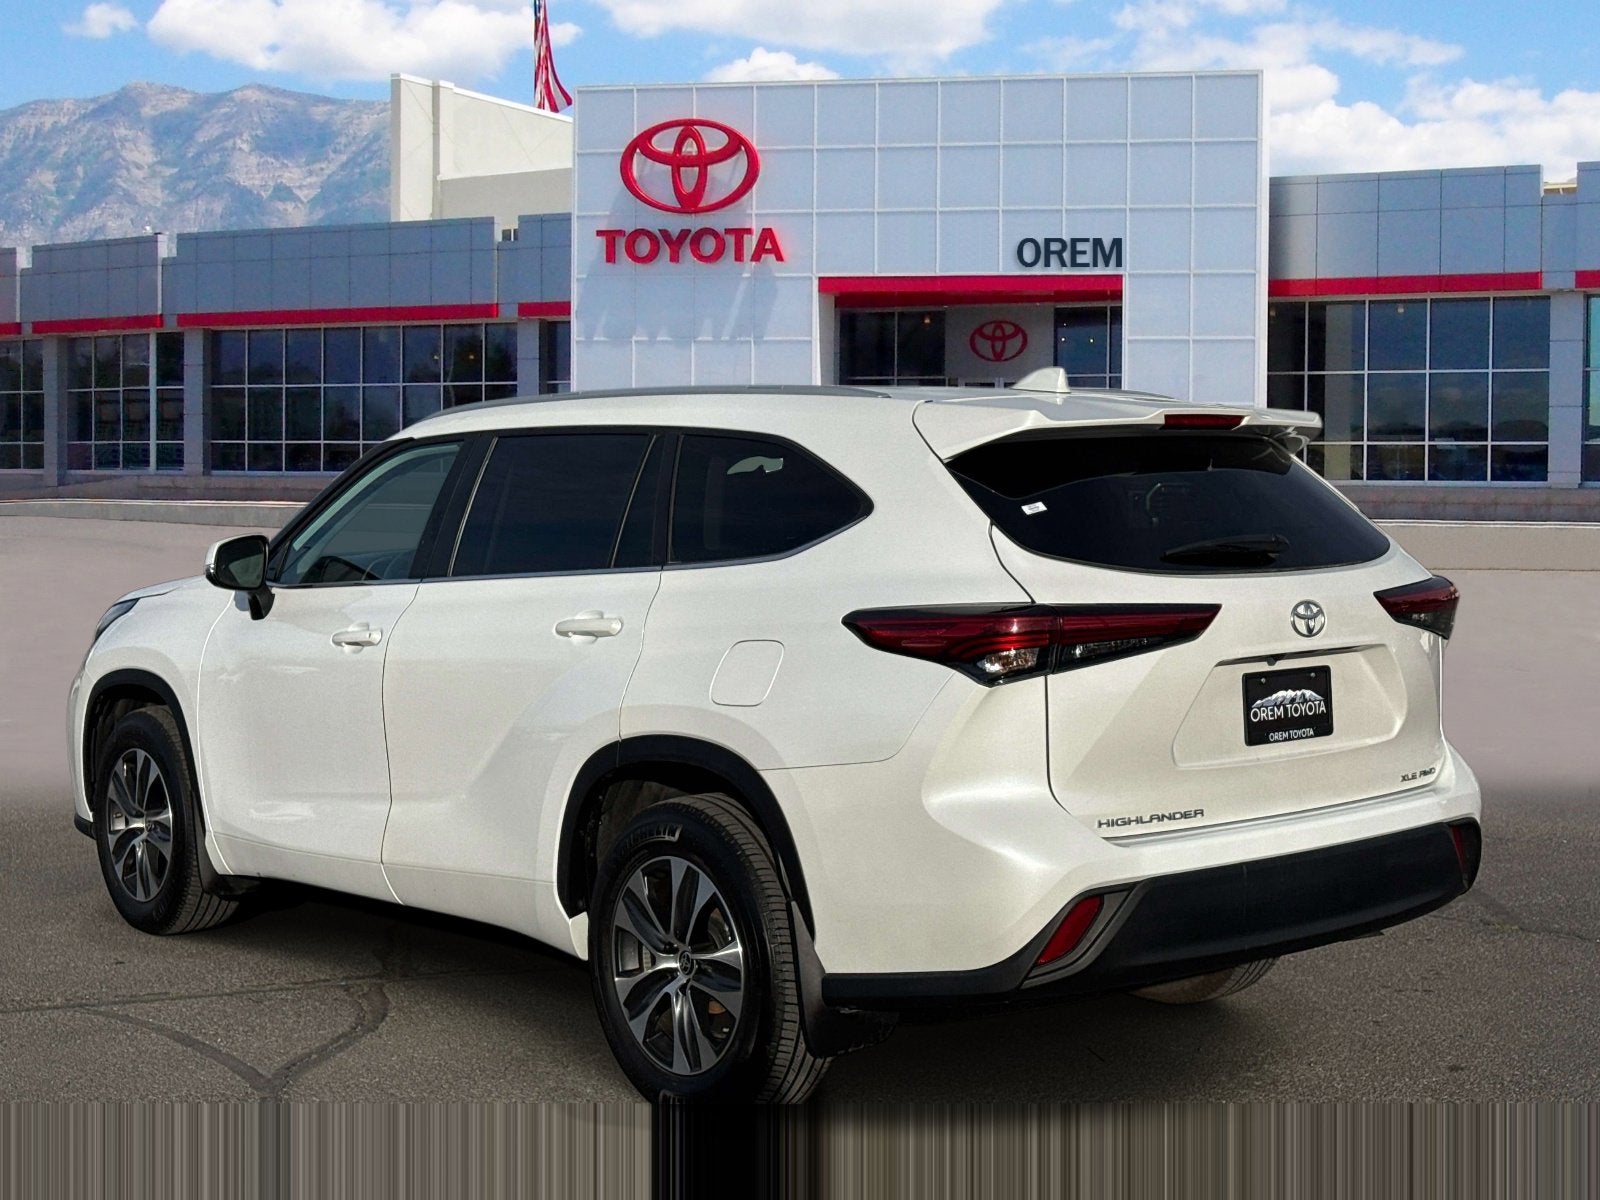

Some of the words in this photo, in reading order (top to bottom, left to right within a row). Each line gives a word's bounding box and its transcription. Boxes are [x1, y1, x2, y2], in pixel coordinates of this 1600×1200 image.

[596, 227, 784, 264] TOYOTA
[1017, 238, 1123, 267] OREM
[1250, 705, 1284, 722] OREM
[1286, 700, 1327, 718] TOYOTA
[1269, 731, 1288, 741] OREM
[1290, 727, 1314, 739] TOYOTA
[1400, 772, 1417, 782] XLE
[1097, 808, 1205, 829] HIGHLANDER
